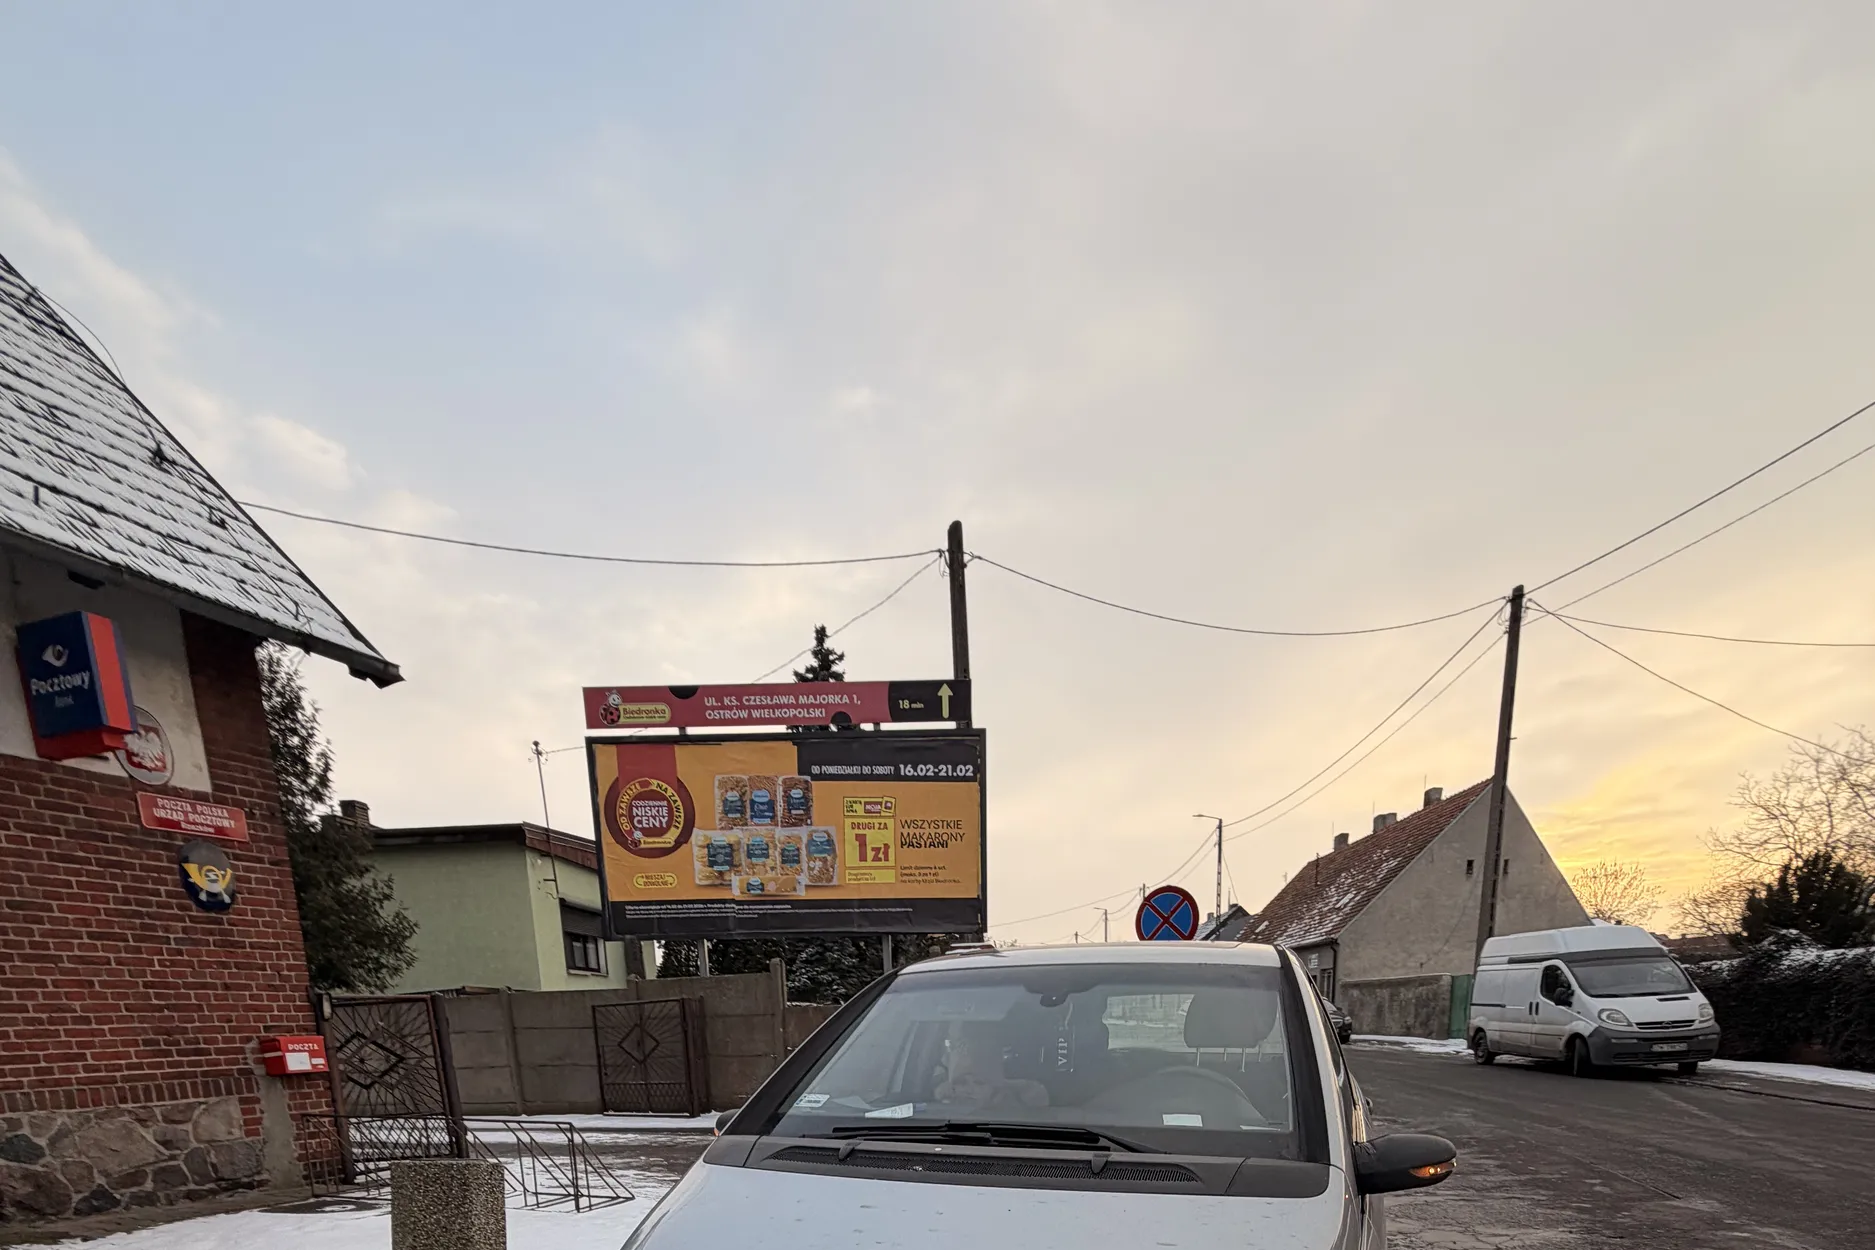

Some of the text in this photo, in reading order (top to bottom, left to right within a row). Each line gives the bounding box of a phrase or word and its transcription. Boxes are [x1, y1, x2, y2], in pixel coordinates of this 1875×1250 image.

[30, 670, 90, 695] Pocztowy
[704, 694, 861, 706] UL. KS. CZESŁAWA MAJORKA 1,
[899, 700, 910, 709] 18
[622, 707, 667, 716] Biedronka
[705, 706, 826, 719] OSTRÓW WIELKOPOLSKI
[811, 765, 894, 775] OD PONIEDZIAŁKU DO SOBOTY
[899, 764, 974, 776] 16.02-21.02
[156, 798, 229, 818] POCZTA POLSKA
[619, 782, 641, 831] OD ZAWSZE
[631, 799, 668, 807] CODZIENNIE
[655, 782, 683, 830] NA ZAWSZE
[632, 807, 668, 816] NISKIE
[187, 813, 236, 829] POCZTOWY
[633, 817, 668, 828] CENY
[851, 822, 888, 830] DRUGI ZA
[900, 820, 962, 830] WSZYSTKIE
[900, 832, 965, 842] MAKARONY
[855, 833, 867, 862] 1
[871, 842, 890, 862] zł
[287, 1043, 320, 1051] POCZTA
